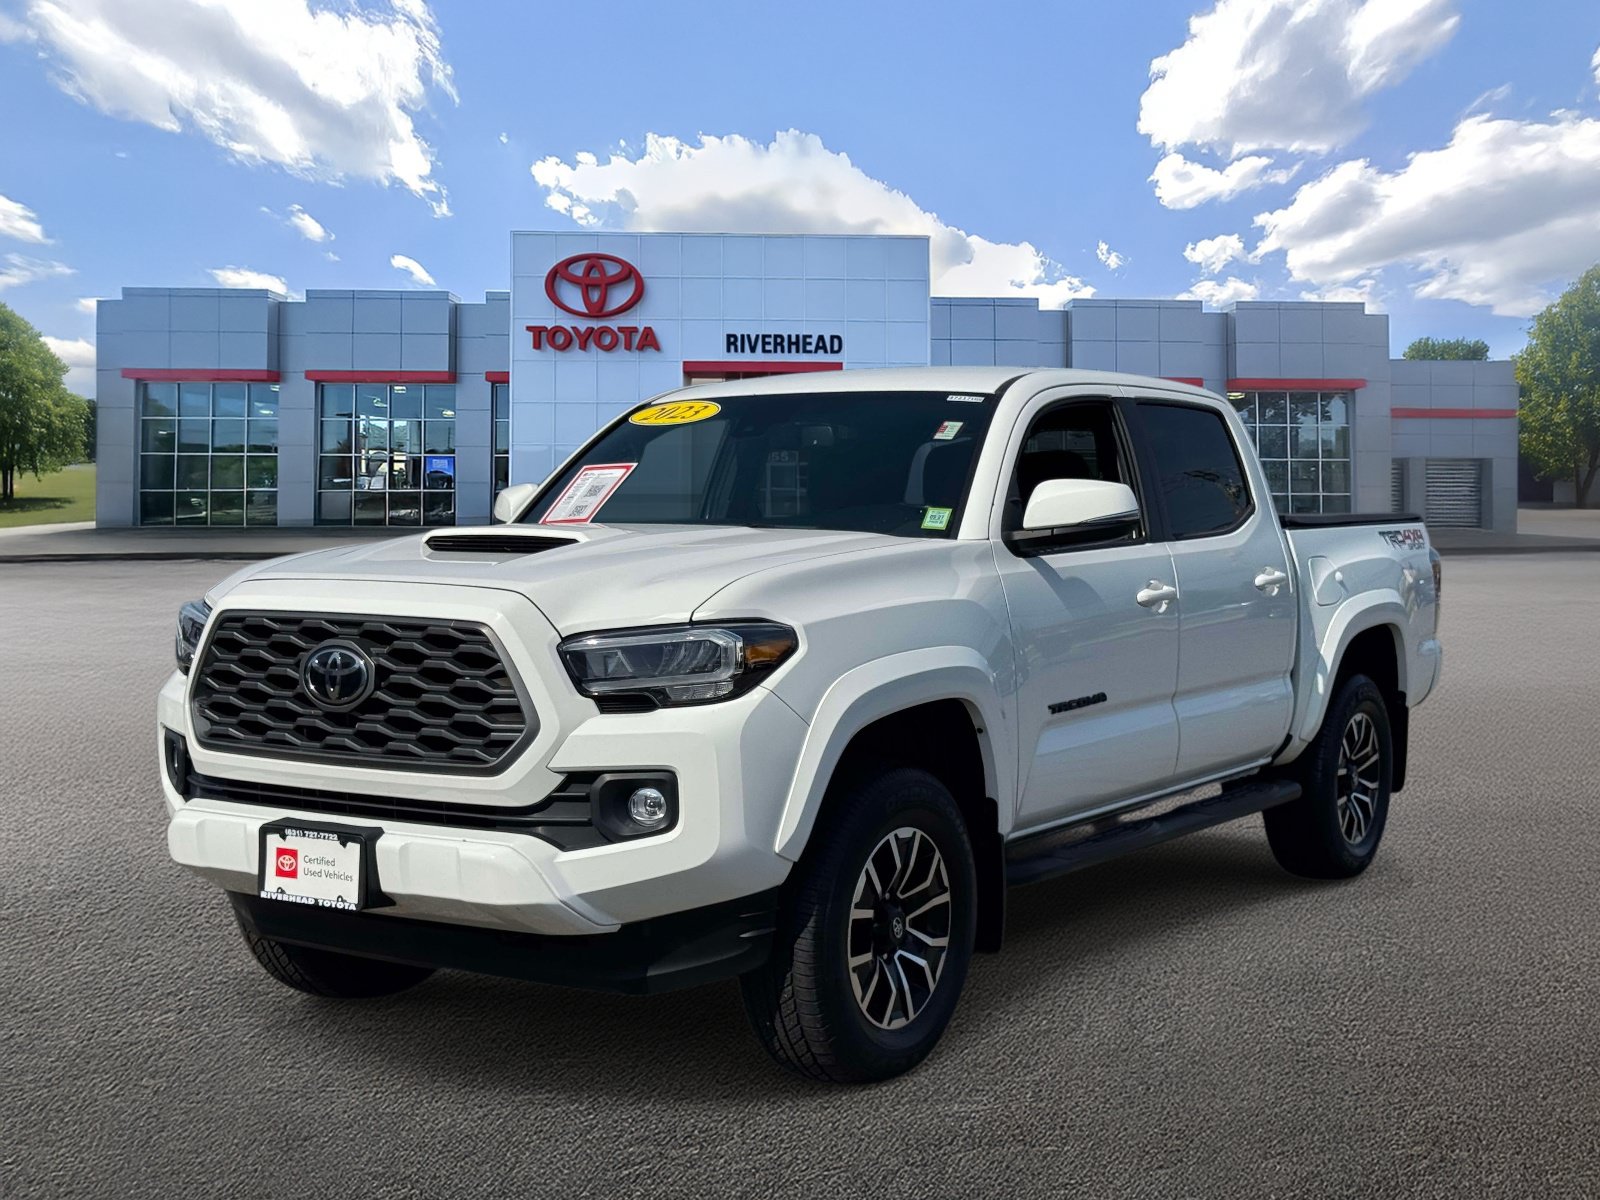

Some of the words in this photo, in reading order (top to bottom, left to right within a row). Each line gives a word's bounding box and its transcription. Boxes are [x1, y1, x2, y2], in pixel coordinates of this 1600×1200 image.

[525, 325, 661, 352] TOYOTA
[726, 333, 843, 354] RIVERHEAD
[639, 406, 710, 421] 2023
[304, 856, 335, 866] Certified
[303, 868, 322, 878] Used
[324, 870, 353, 882] Vehicles
[260, 890, 315, 905] RIVERHEAD
[318, 898, 356, 911] TOYOTA
